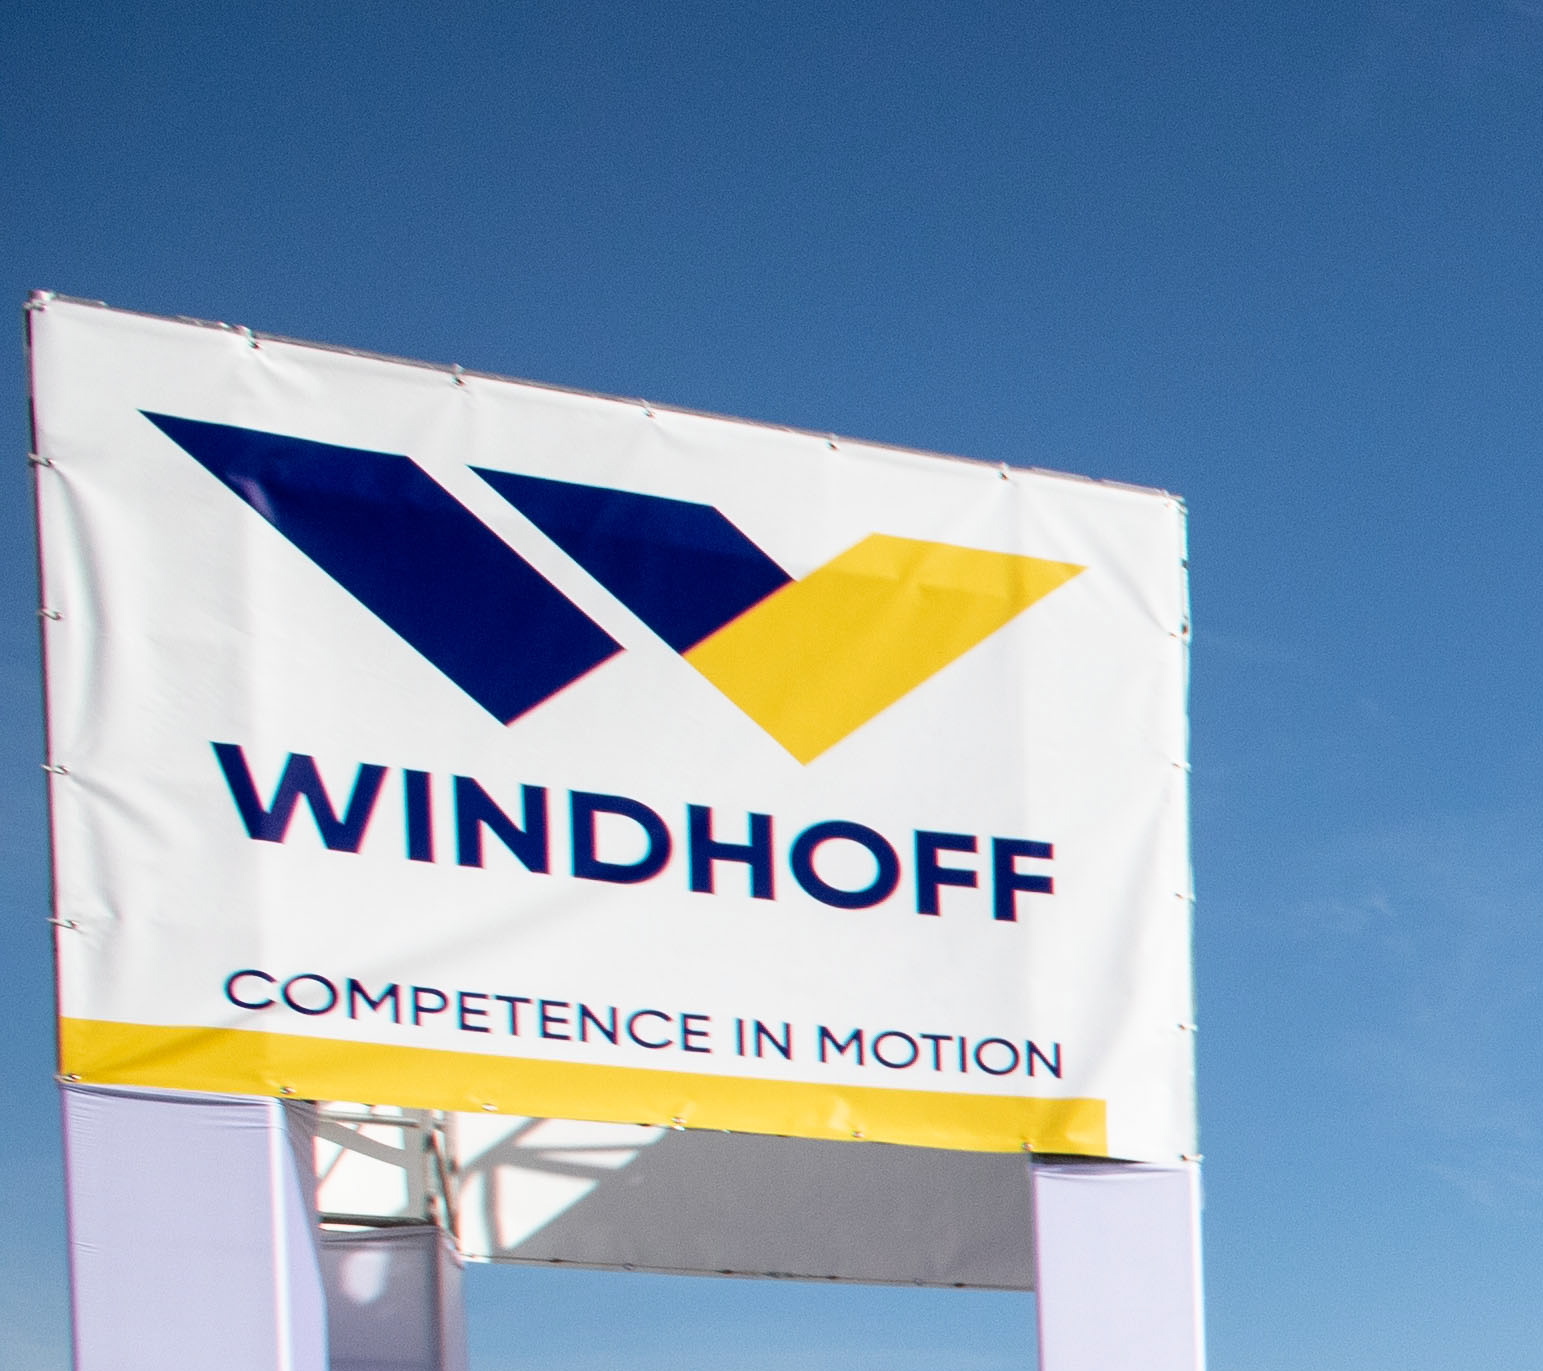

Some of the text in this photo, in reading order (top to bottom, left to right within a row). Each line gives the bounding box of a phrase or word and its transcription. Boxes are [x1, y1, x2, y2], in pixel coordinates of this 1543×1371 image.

[210, 741, 1055, 924] WINDHOFF
[224, 968, 1063, 1080] COMPETENCE IN MOTION
